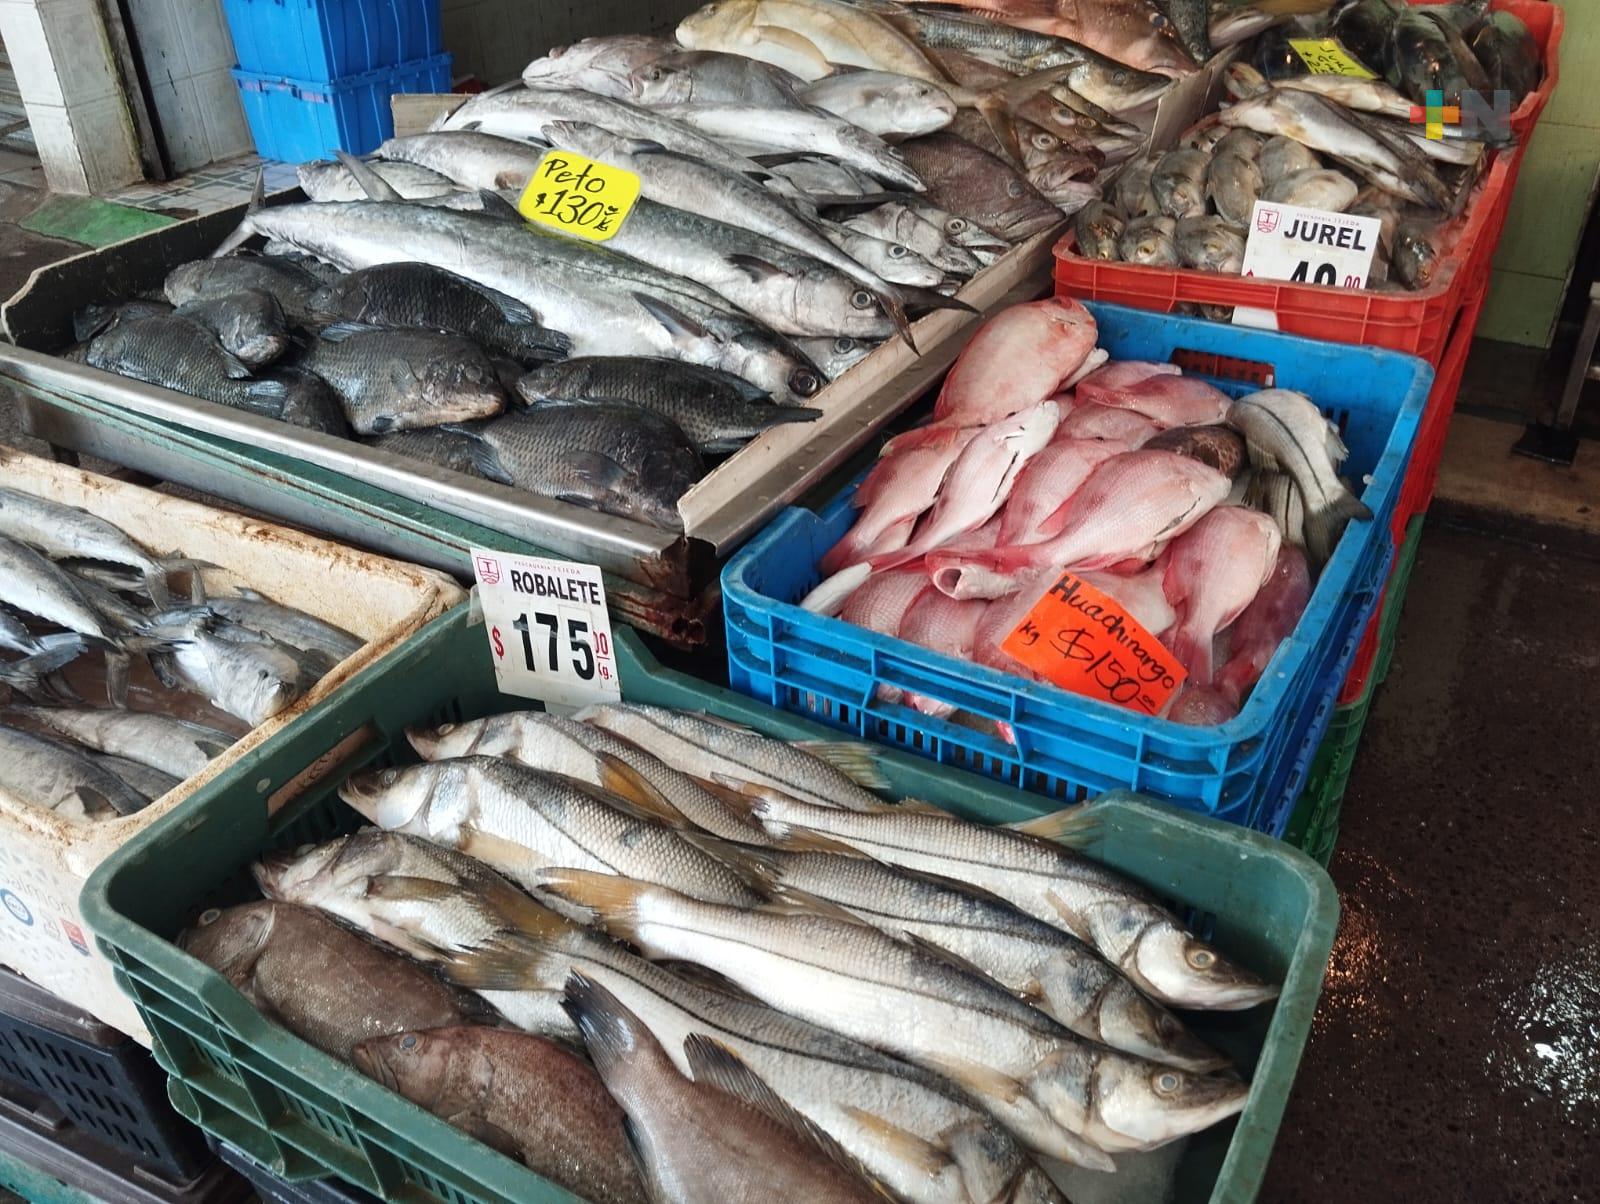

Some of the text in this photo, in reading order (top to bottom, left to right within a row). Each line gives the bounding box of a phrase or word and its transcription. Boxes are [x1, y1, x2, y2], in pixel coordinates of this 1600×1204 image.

[545, 159, 605, 193] Peto
[1284, 220, 1367, 251] JUREL
[510, 570, 601, 605] ROBALETE
[512, 612, 595, 681] 175
[1049, 575, 1175, 689] Huachinango
